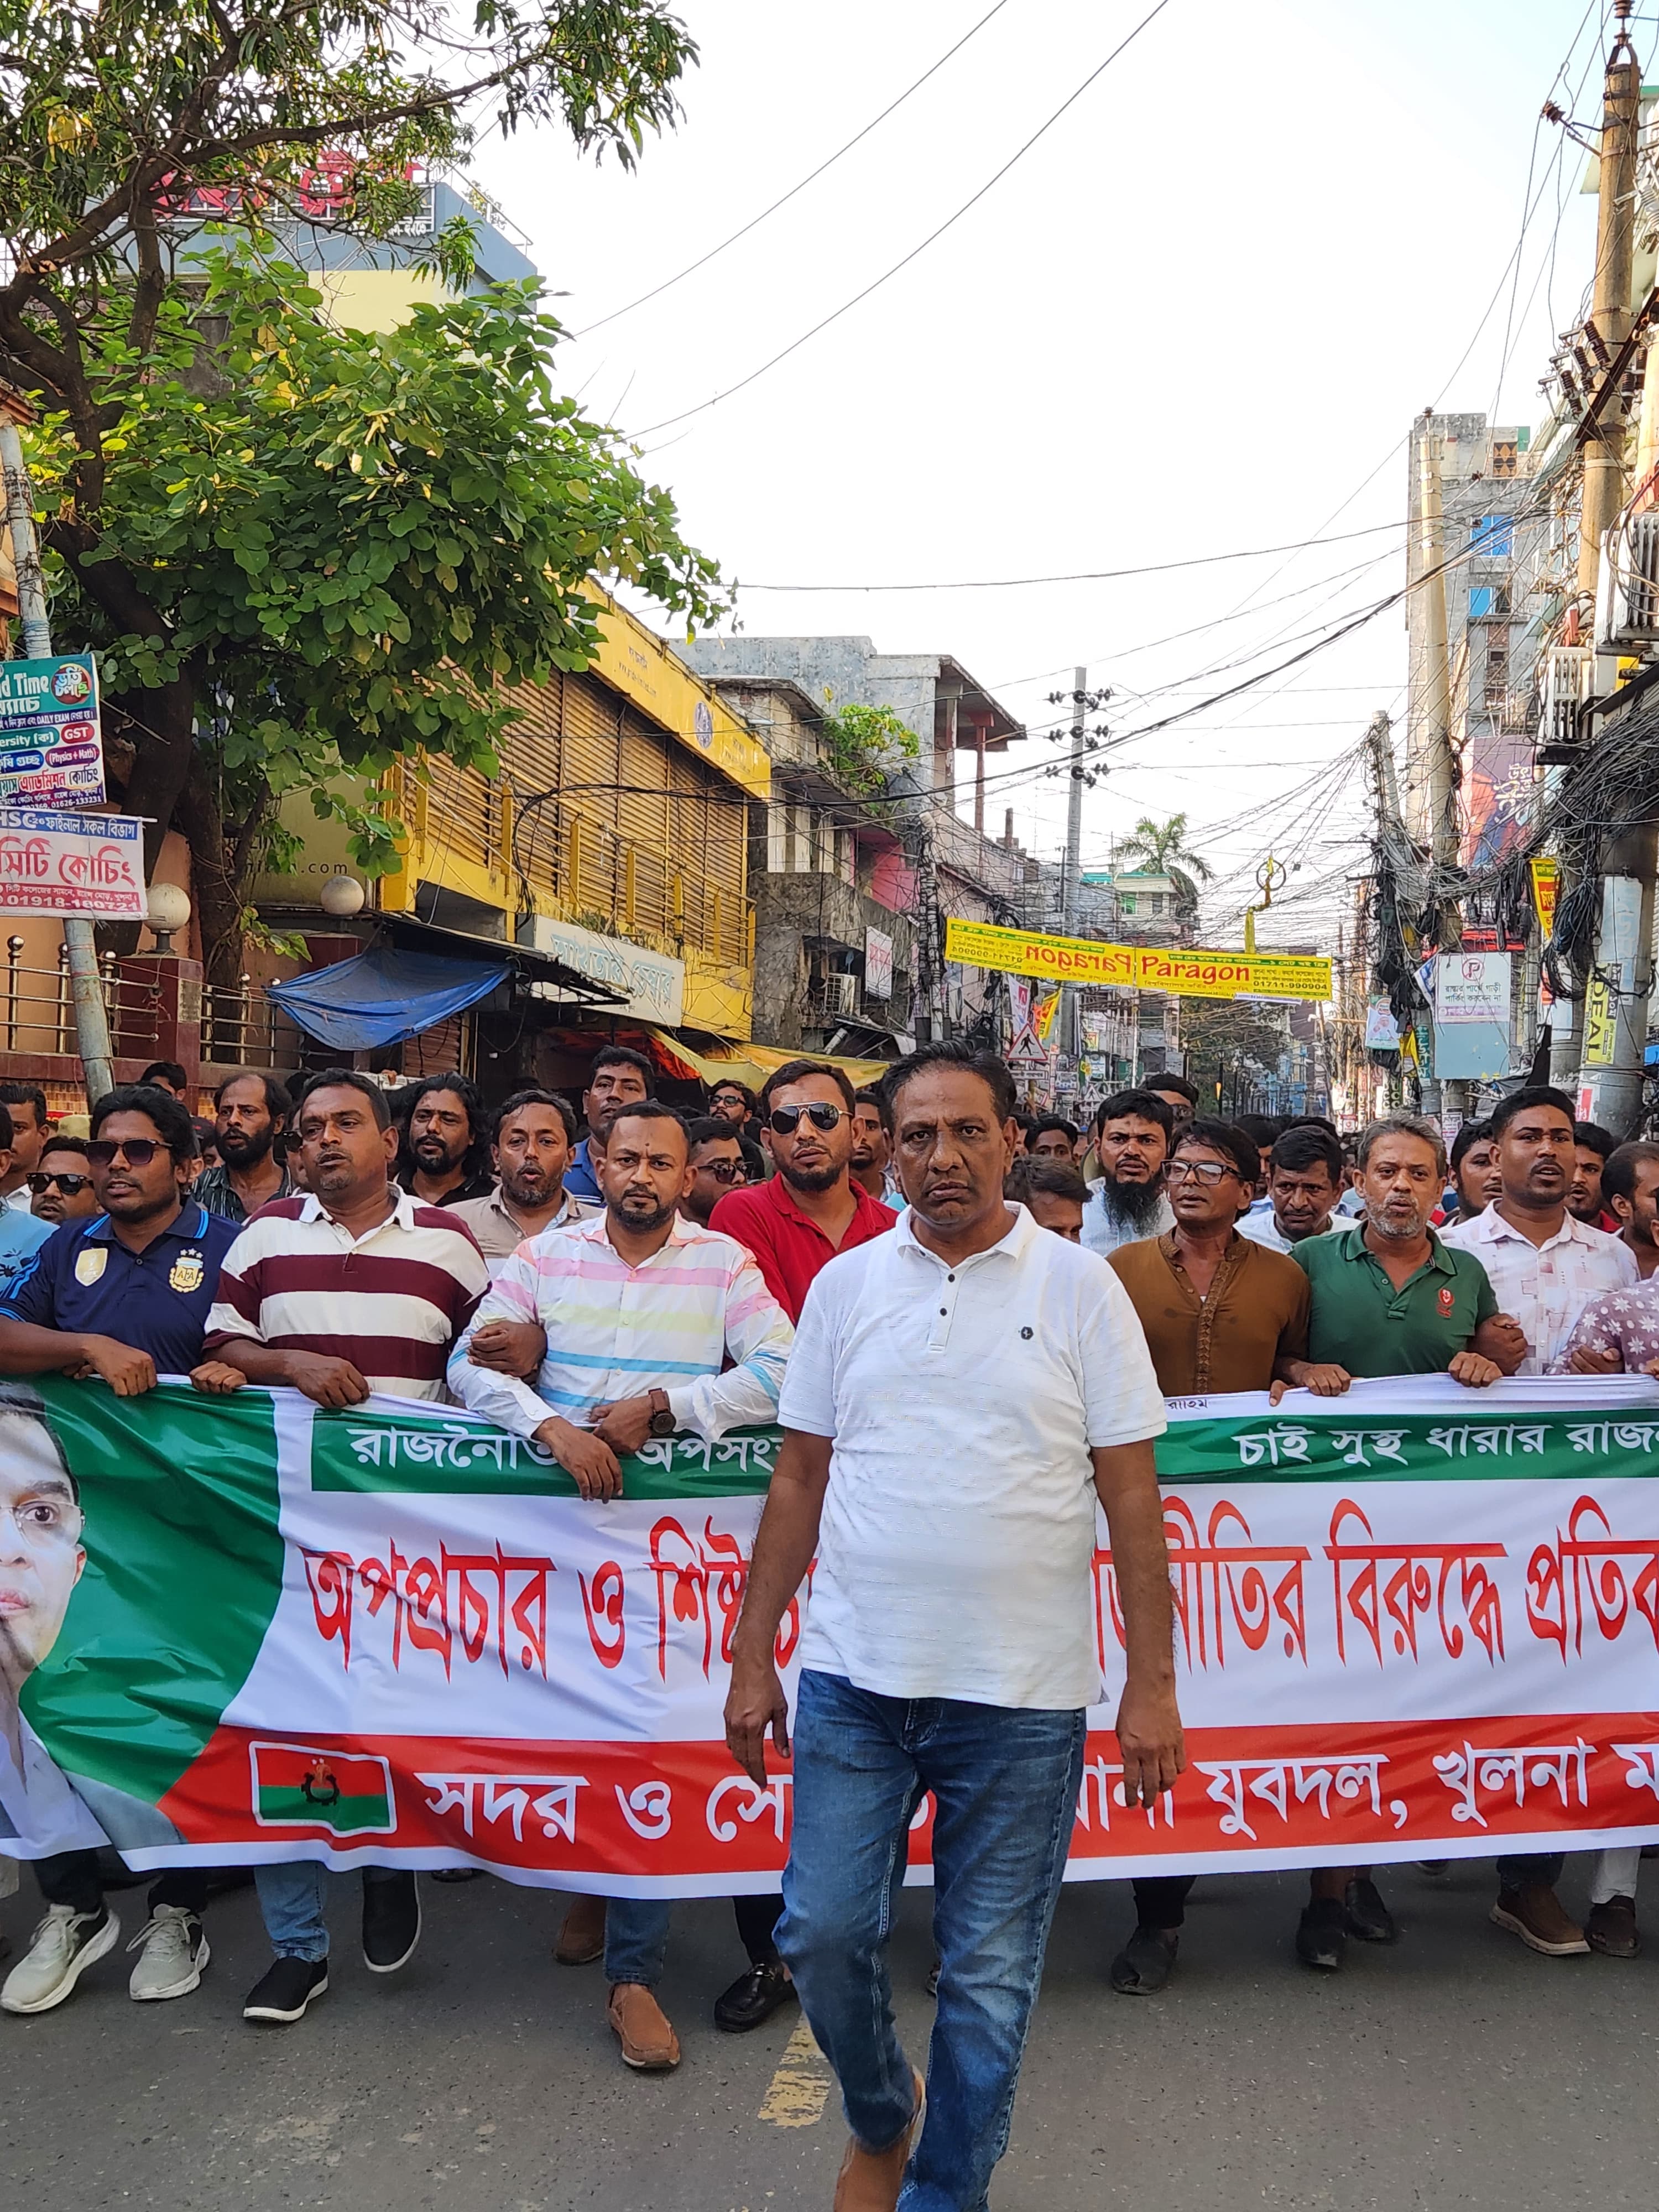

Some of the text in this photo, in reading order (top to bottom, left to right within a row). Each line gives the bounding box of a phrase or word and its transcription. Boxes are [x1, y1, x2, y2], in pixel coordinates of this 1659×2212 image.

[13, 672, 49, 696] Time
[36, 714, 54, 724] DAILY
[55, 713, 70, 723] EXAM
[64, 727, 88, 740] GST
[49, 752, 72, 765] (Physics
[79, 748, 97, 760] Math)
[69, 763, 98, 785] কোচিং
[51, 795, 102, 809] 01626-133231
[44, 813, 81, 833] ফাইনাল
[82, 818, 105, 835] সকল
[108, 817, 135, 839] বিভাগ
[58, 845, 136, 889] কোচিং
[1141, 954, 1250, 985] Paragon
[1253, 981, 1327, 990] 01711-990904
[1493, 994, 1502, 1003] না
[1230, 1421, 1317, 1467] চাই
[1329, 1427, 1411, 1467] সুস্থ
[1426, 1422, 1554, 1457] ধারার
[1323, 1496, 1510, 1670] বিরুদ্ধে
[299, 1536, 556, 1684] অপপ্রচার
[577, 1559, 627, 1670] ও
[1193, 1753, 1408, 1843] যুবদল,
[1431, 1735, 1599, 1829] খুলনা
[413, 1771, 591, 1845] সদর
[615, 1780, 672, 1842] ও
